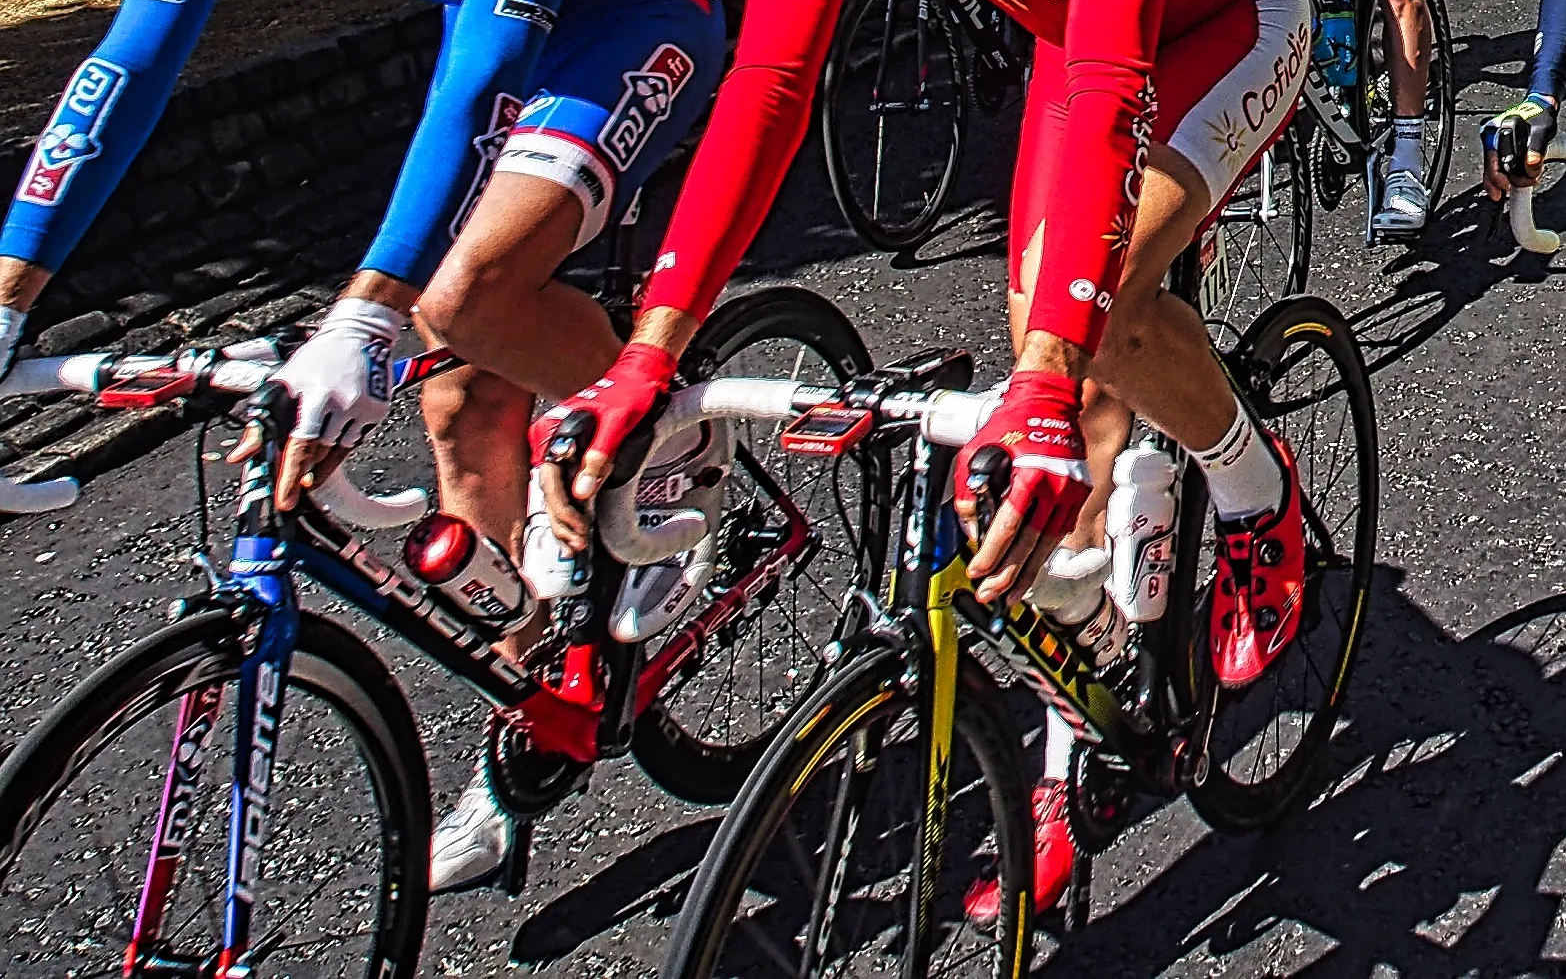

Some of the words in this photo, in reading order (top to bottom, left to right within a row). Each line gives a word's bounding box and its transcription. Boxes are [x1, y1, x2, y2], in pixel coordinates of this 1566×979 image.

[69, 64, 112, 117] FDJ
[611, 105, 646, 159] FDJ
[667, 56, 685, 81] .fr
[1242, 21, 1309, 133] Cofidis
